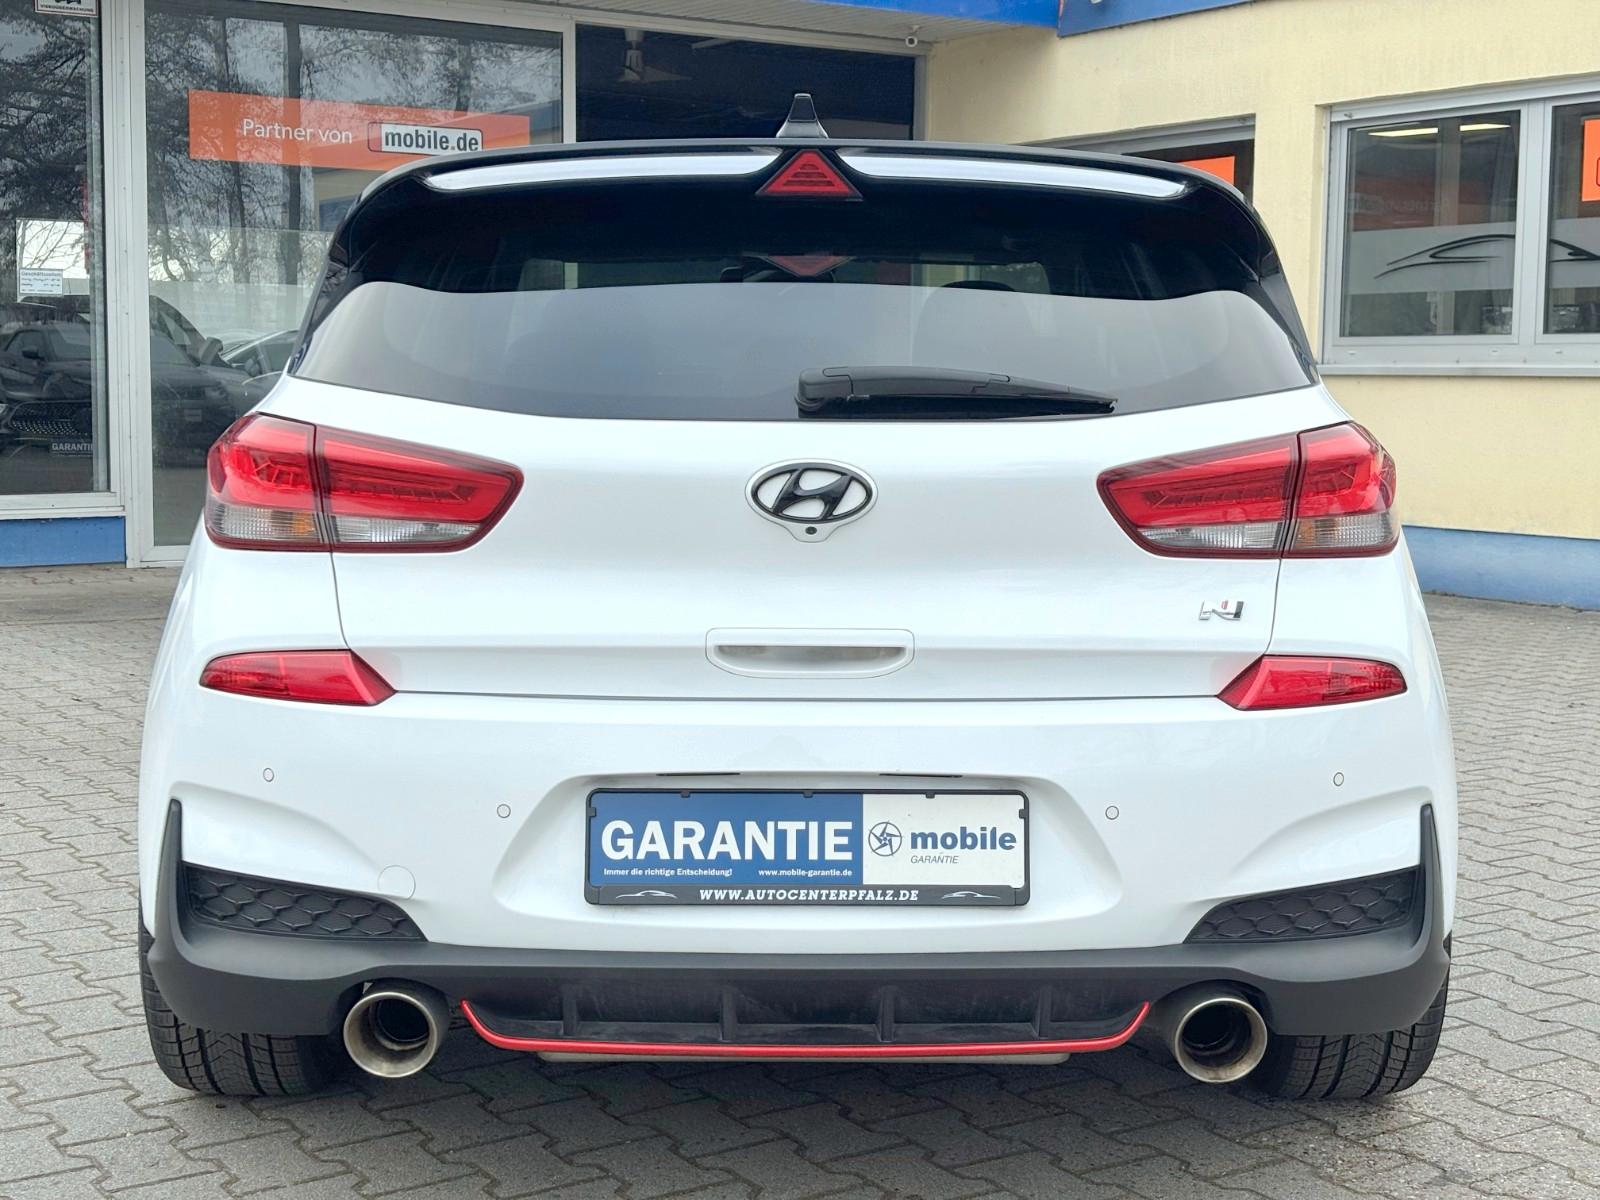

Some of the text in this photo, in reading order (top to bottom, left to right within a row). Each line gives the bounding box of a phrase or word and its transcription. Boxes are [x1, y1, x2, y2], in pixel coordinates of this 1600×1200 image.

[242, 118, 480, 152] Partner von mobile.de
[51, 442, 93, 451] GARANTI
[602, 820, 853, 860] GARANTIE
[910, 826, 1017, 850] mobile
[910, 855, 960, 864] GARANTIE
[603, 868, 733, 877] Immer die richtige Entscheidung!
[758, 868, 853, 877] www.mobile-garantie.de
[699, 889, 919, 901] WWW.AUTOCENTERPFALZ.DE
